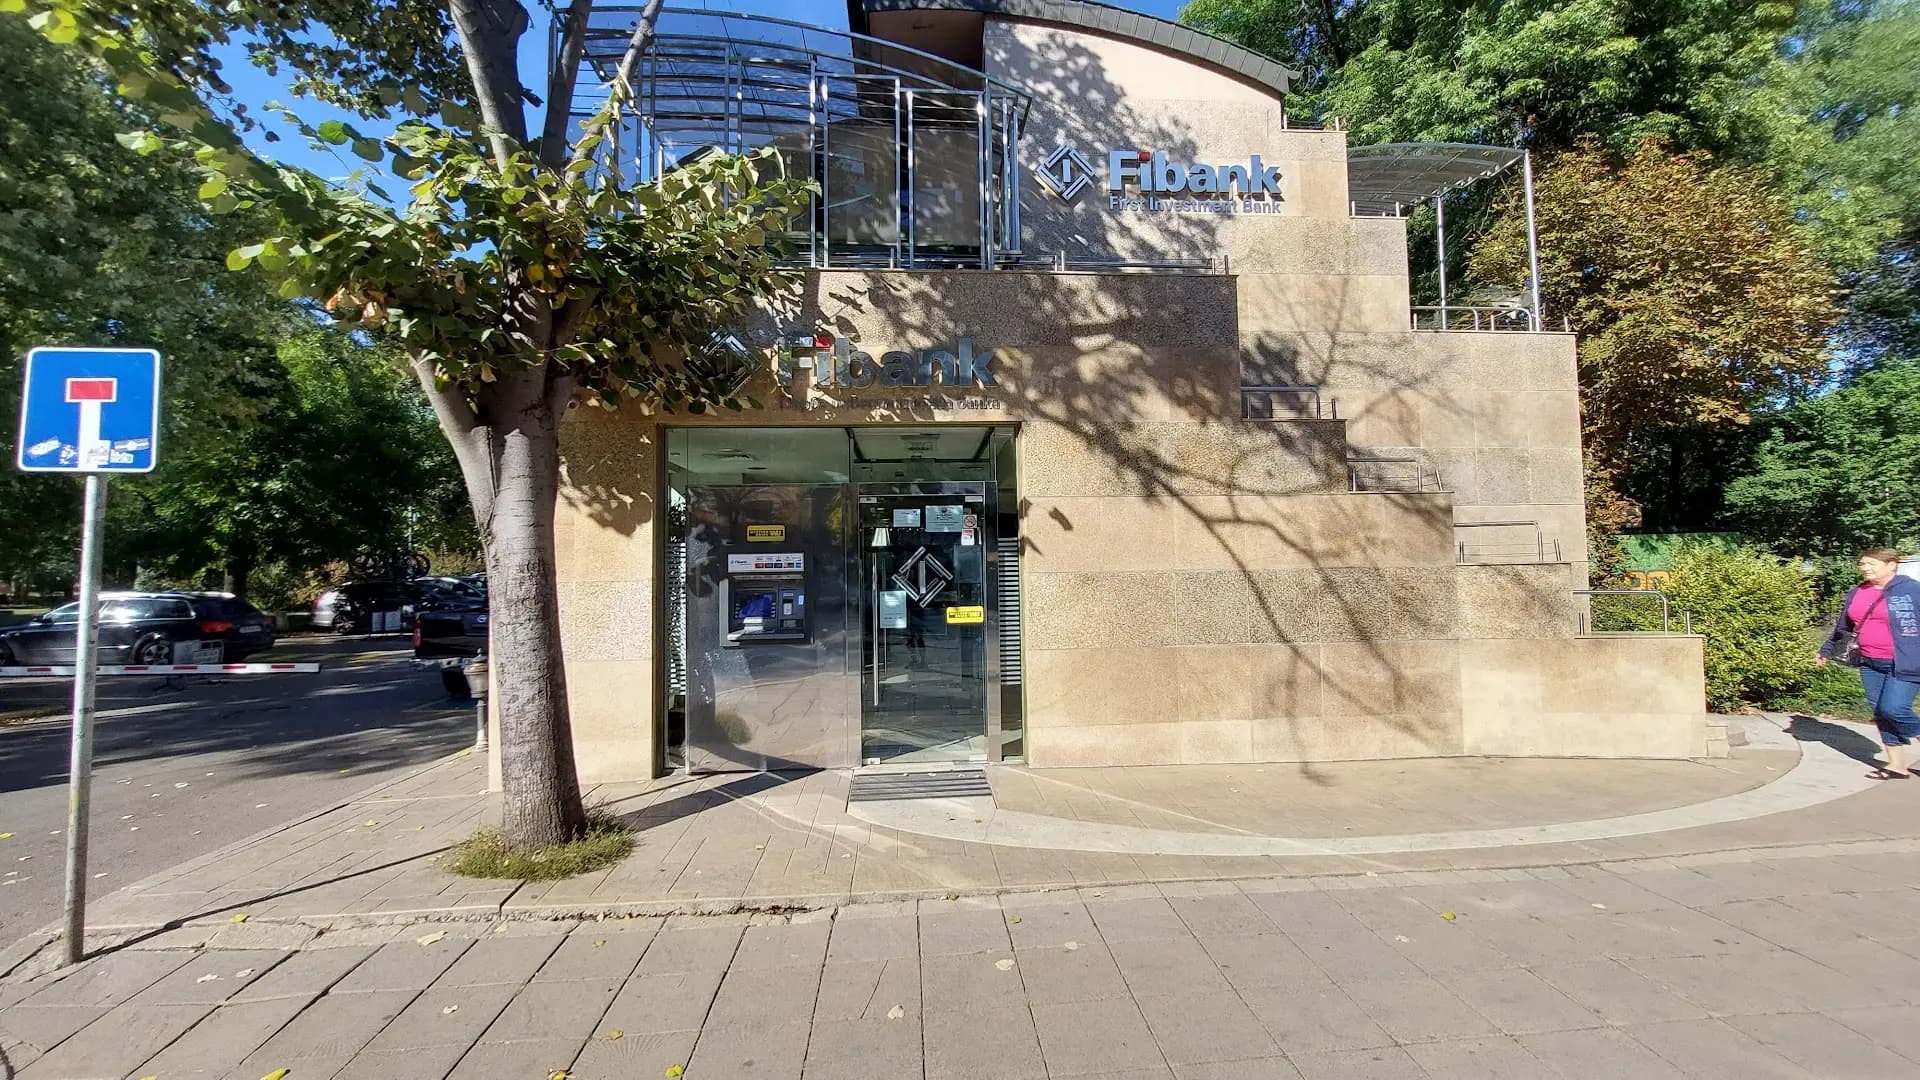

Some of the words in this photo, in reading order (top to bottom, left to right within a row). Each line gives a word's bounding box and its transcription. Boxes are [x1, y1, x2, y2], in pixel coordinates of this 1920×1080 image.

[1109, 150, 1283, 194] Fibank
[1109, 196, 1145, 211] First
[1150, 197, 1238, 213] Investment
[1243, 200, 1281, 213] Bank
[778, 336, 997, 386] Fibank
